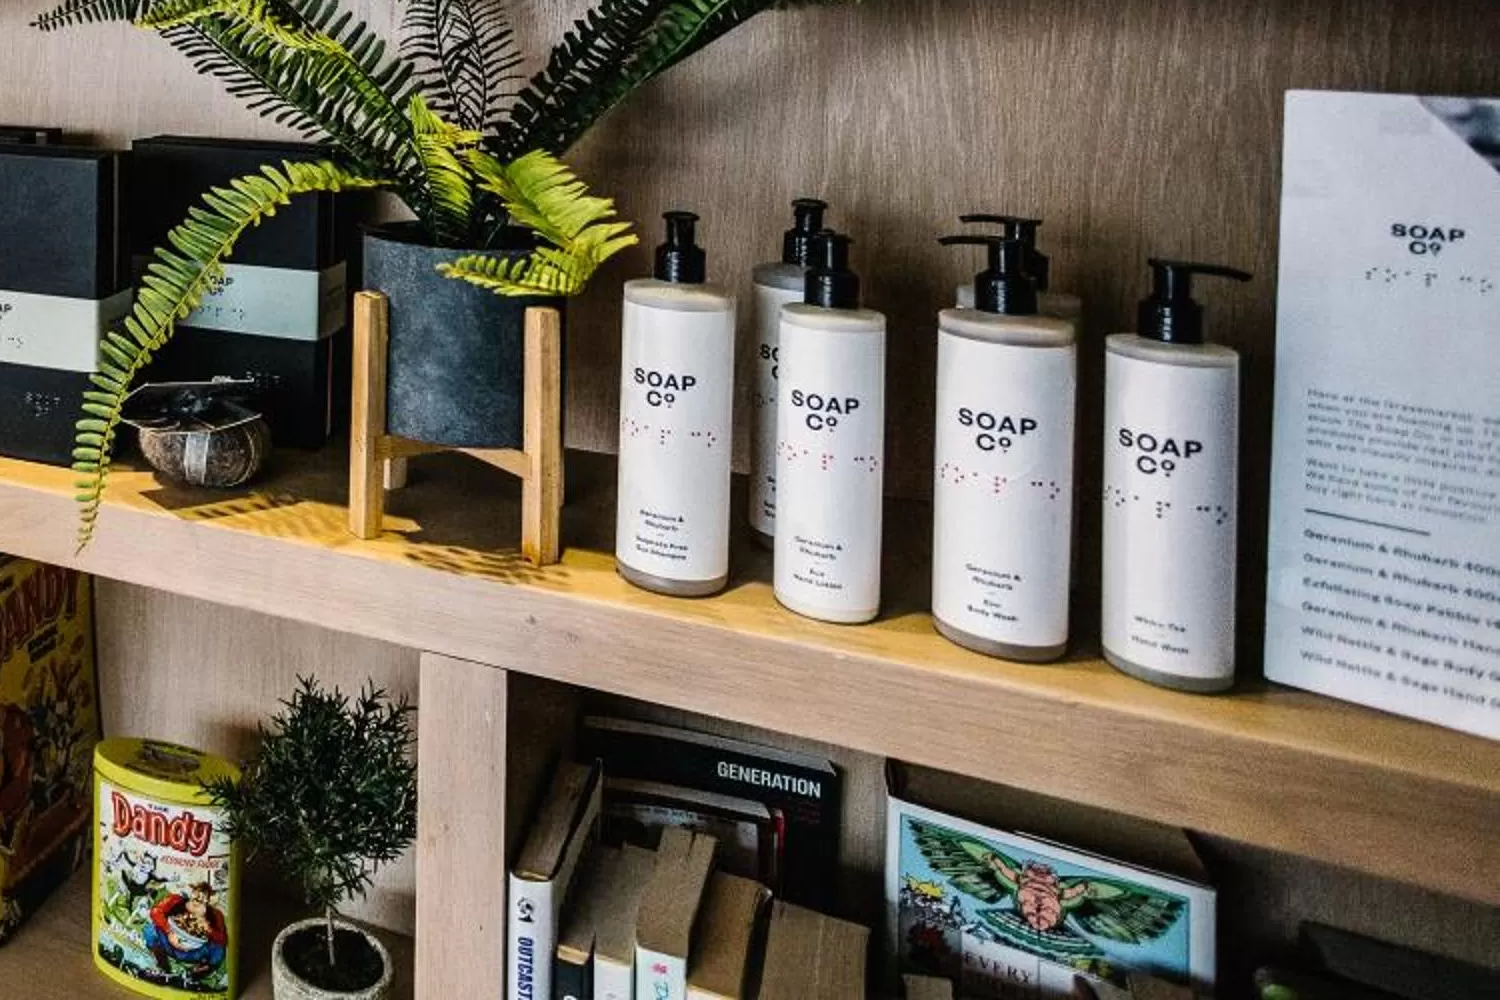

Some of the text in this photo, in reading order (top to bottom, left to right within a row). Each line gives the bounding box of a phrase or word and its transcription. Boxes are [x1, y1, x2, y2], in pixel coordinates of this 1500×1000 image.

[1390, 223, 1465, 243] SOAP
[204, 276, 233, 287] OAP
[633, 368, 696, 391] SOAP
[791, 390, 860, 415] SOAP
[958, 408, 1038, 435] SOAP
[1118, 428, 1203, 459] SOAP
[1306, 469, 1326, 481] We
[1378, 543, 1388, 554] &
[1393, 545, 1459, 570] Rhubarb
[1378, 568, 1388, 579] &
[1392, 571, 1459, 596] Rhubarb
[1376, 617, 1387, 629] &
[1392, 621, 1458, 646] Rhubarb
[1386, 646, 1396, 657] &
[1386, 671, 1396, 682] &
[717, 761, 822, 799] GENERATION
[147, 802, 169, 813] THE
[111, 791, 213, 857] Dandy
[962, 951, 1035, 984] EVERY
